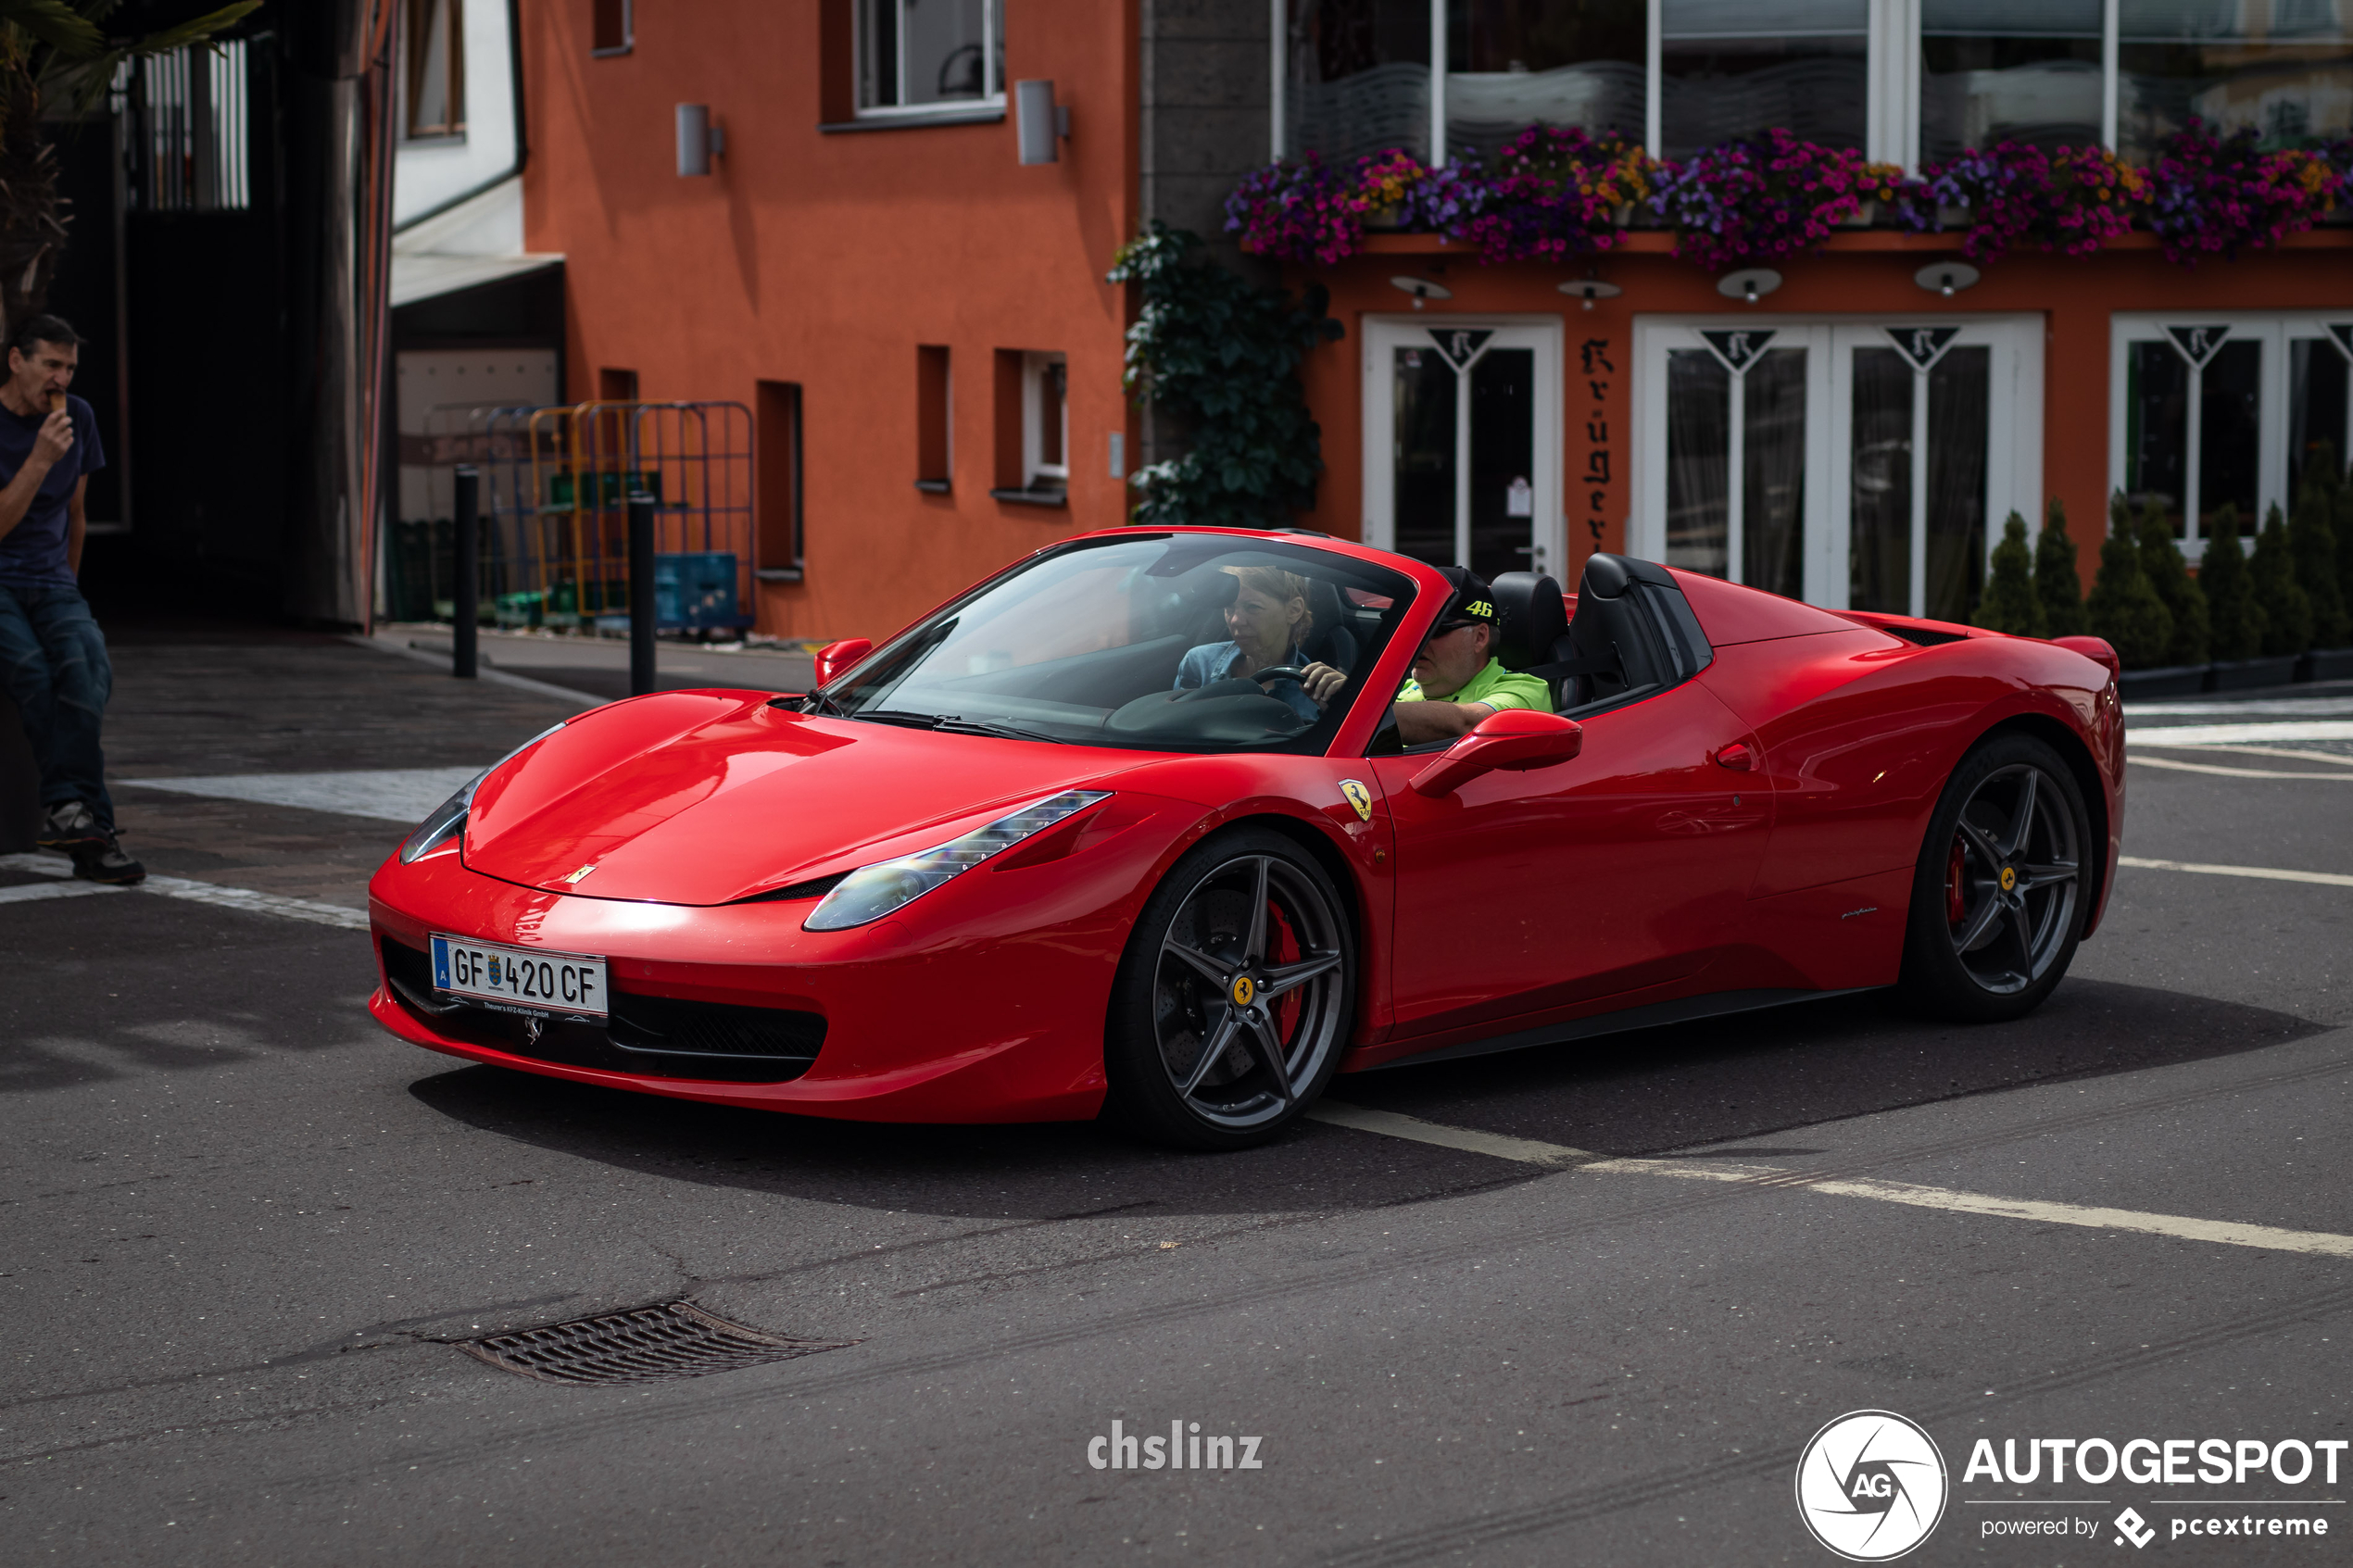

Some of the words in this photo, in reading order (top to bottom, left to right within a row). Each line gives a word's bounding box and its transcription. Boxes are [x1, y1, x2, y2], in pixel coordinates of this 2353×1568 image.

[1466, 600, 1492, 618] 46
[440, 971, 447, 982] A
[455, 948, 483, 986] GF
[506, 956, 555, 999] 420
[561, 964, 595, 1004] CF
[507, 1006, 533, 1017] KFZ-Klinik
[533, 1010, 549, 1019] GmbH
